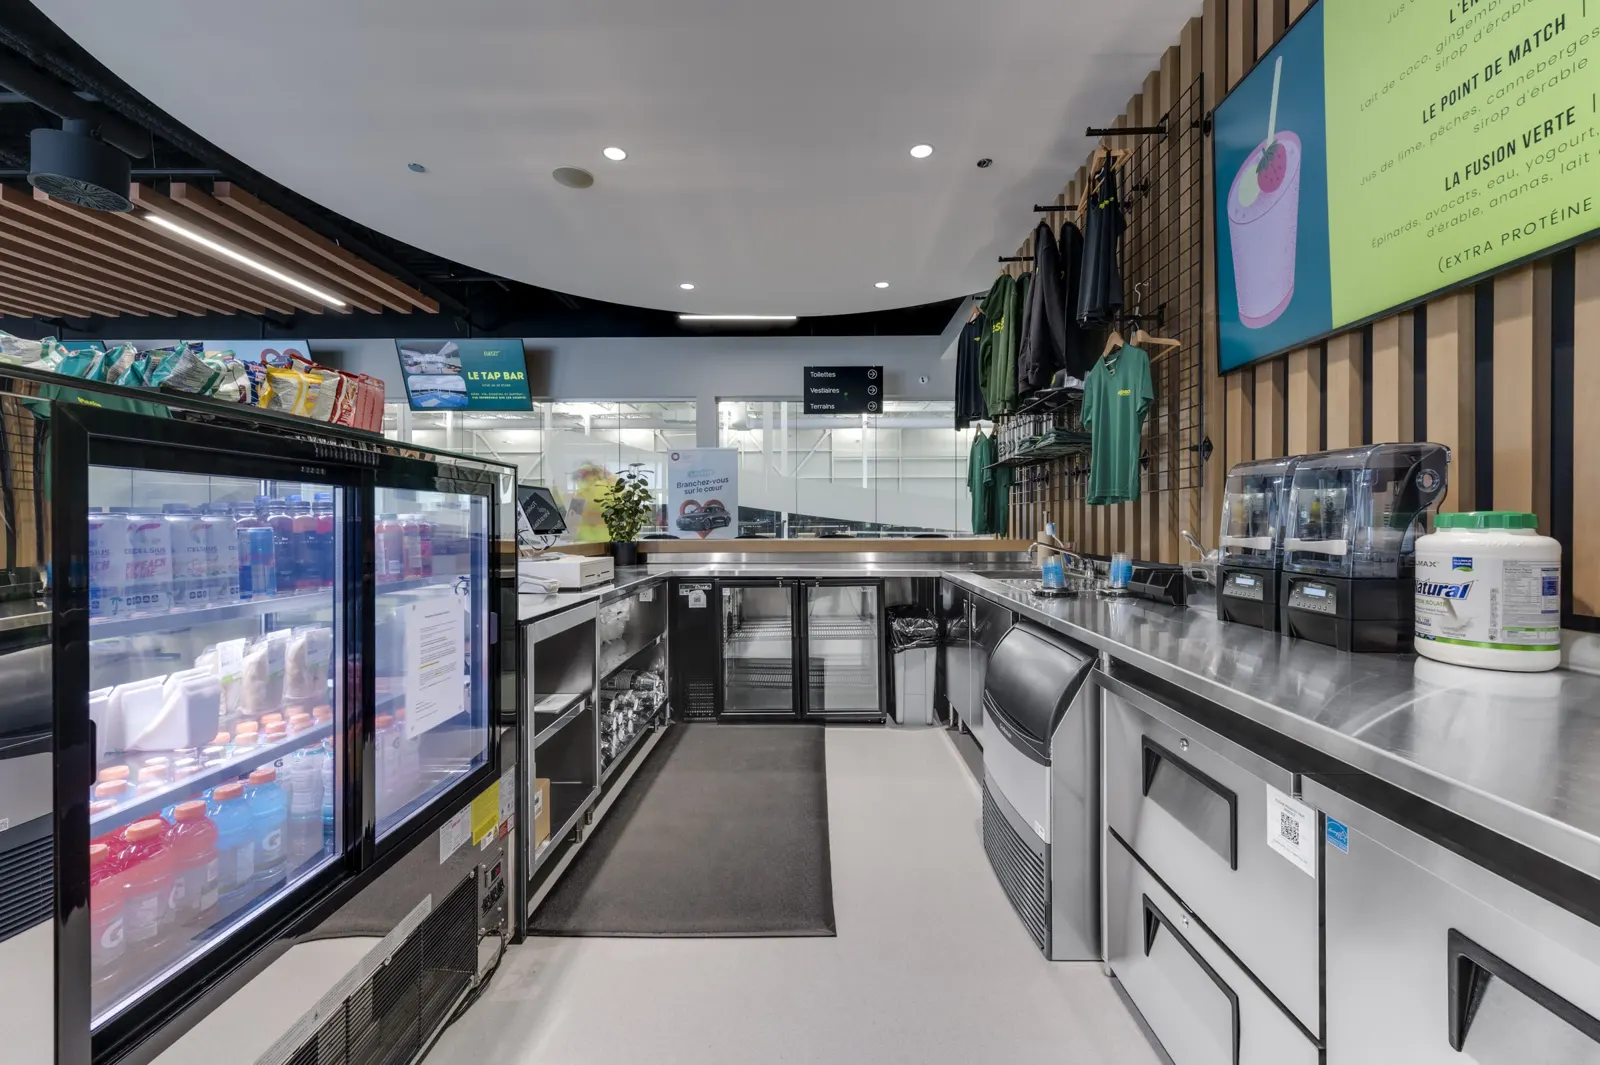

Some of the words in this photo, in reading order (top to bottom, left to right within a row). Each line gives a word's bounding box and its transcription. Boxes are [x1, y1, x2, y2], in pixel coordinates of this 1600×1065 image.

[1360, 92, 1378, 112] Lait
[1381, 80, 1395, 95] de
[1435, 0, 1502, 56] gingemb
[1422, 102, 1437, 125] LE
[1441, 73, 1480, 112] POINT
[1484, 57, 1503, 83] DE
[1508, 13, 1566, 67] MATCH
[1436, 43, 1468, 72] sirop
[1473, 106, 1510, 133] sirop
[1516, 58, 1588, 107] d'érable
[1360, 170, 1377, 186] Jus
[1380, 159, 1394, 173] de
[1444, 171, 1461, 192] LA
[1465, 139, 1516, 181] FUSION
[1522, 105, 1576, 149] VERTE
[1425, 188, 1482, 221] avocats,
[1486, 169, 1519, 190] eau,
[1426, 206, 1484, 238] d'érable,
[1489, 173, 1553, 208] ananas,
[1560, 152, 1590, 175] lait
[1438, 240, 1493, 273] (EXTRA
[1501, 196, 1593, 246] PROTÉINE
[467, 371, 479, 380] LE
[480, 371, 501, 380] TAP
[503, 371, 525, 380] BAR
[676, 477, 729, 489] Branchez-vous
